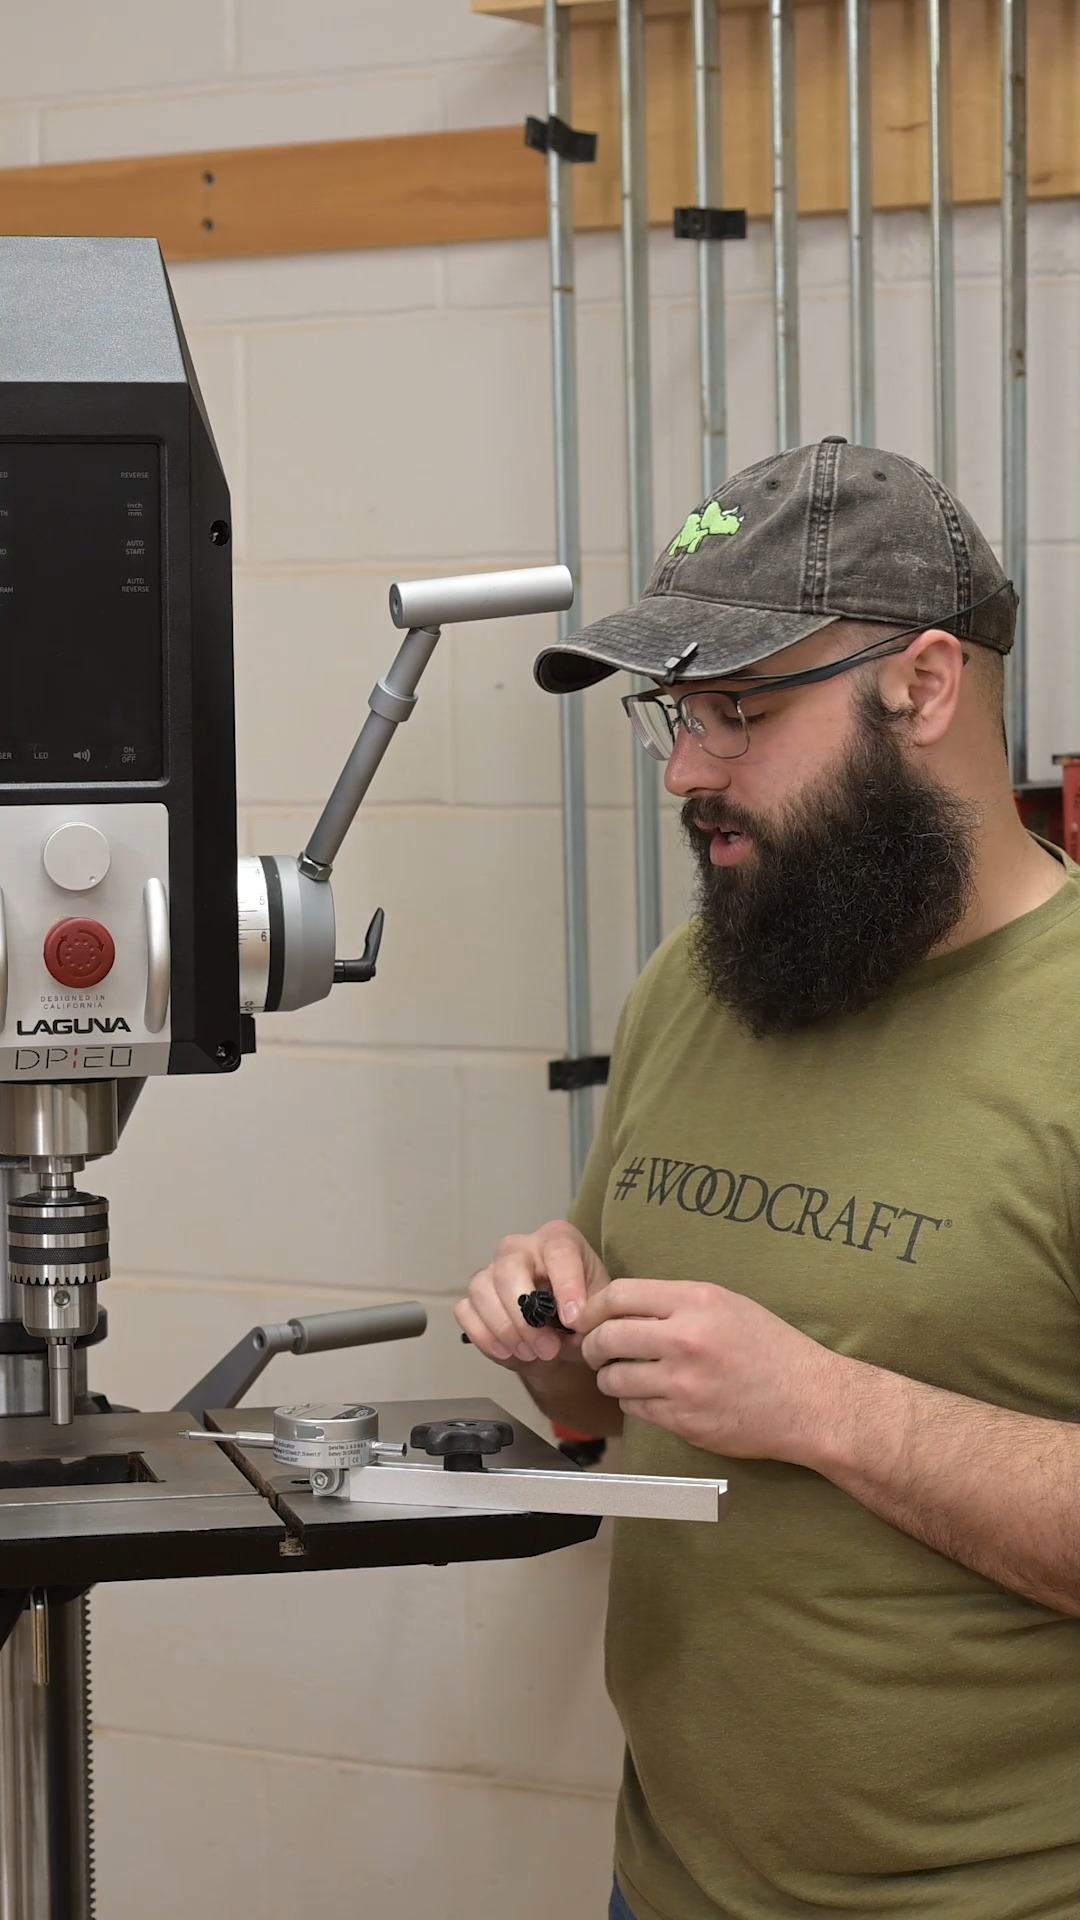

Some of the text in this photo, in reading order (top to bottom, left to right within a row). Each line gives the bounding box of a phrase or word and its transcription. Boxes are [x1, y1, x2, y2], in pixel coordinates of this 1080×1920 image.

[120, 471, 149, 479] REVERSE
[123, 746, 135, 754] ON
[34, 752, 48, 760] LED
[259, 896, 265, 906] 5
[261, 931, 268, 942] 6
[40, 994, 91, 1003] DESIGNED
[43, 1002, 103, 1010] CALIFORNIA
[16, 1017, 132, 1036] LAGUNA
